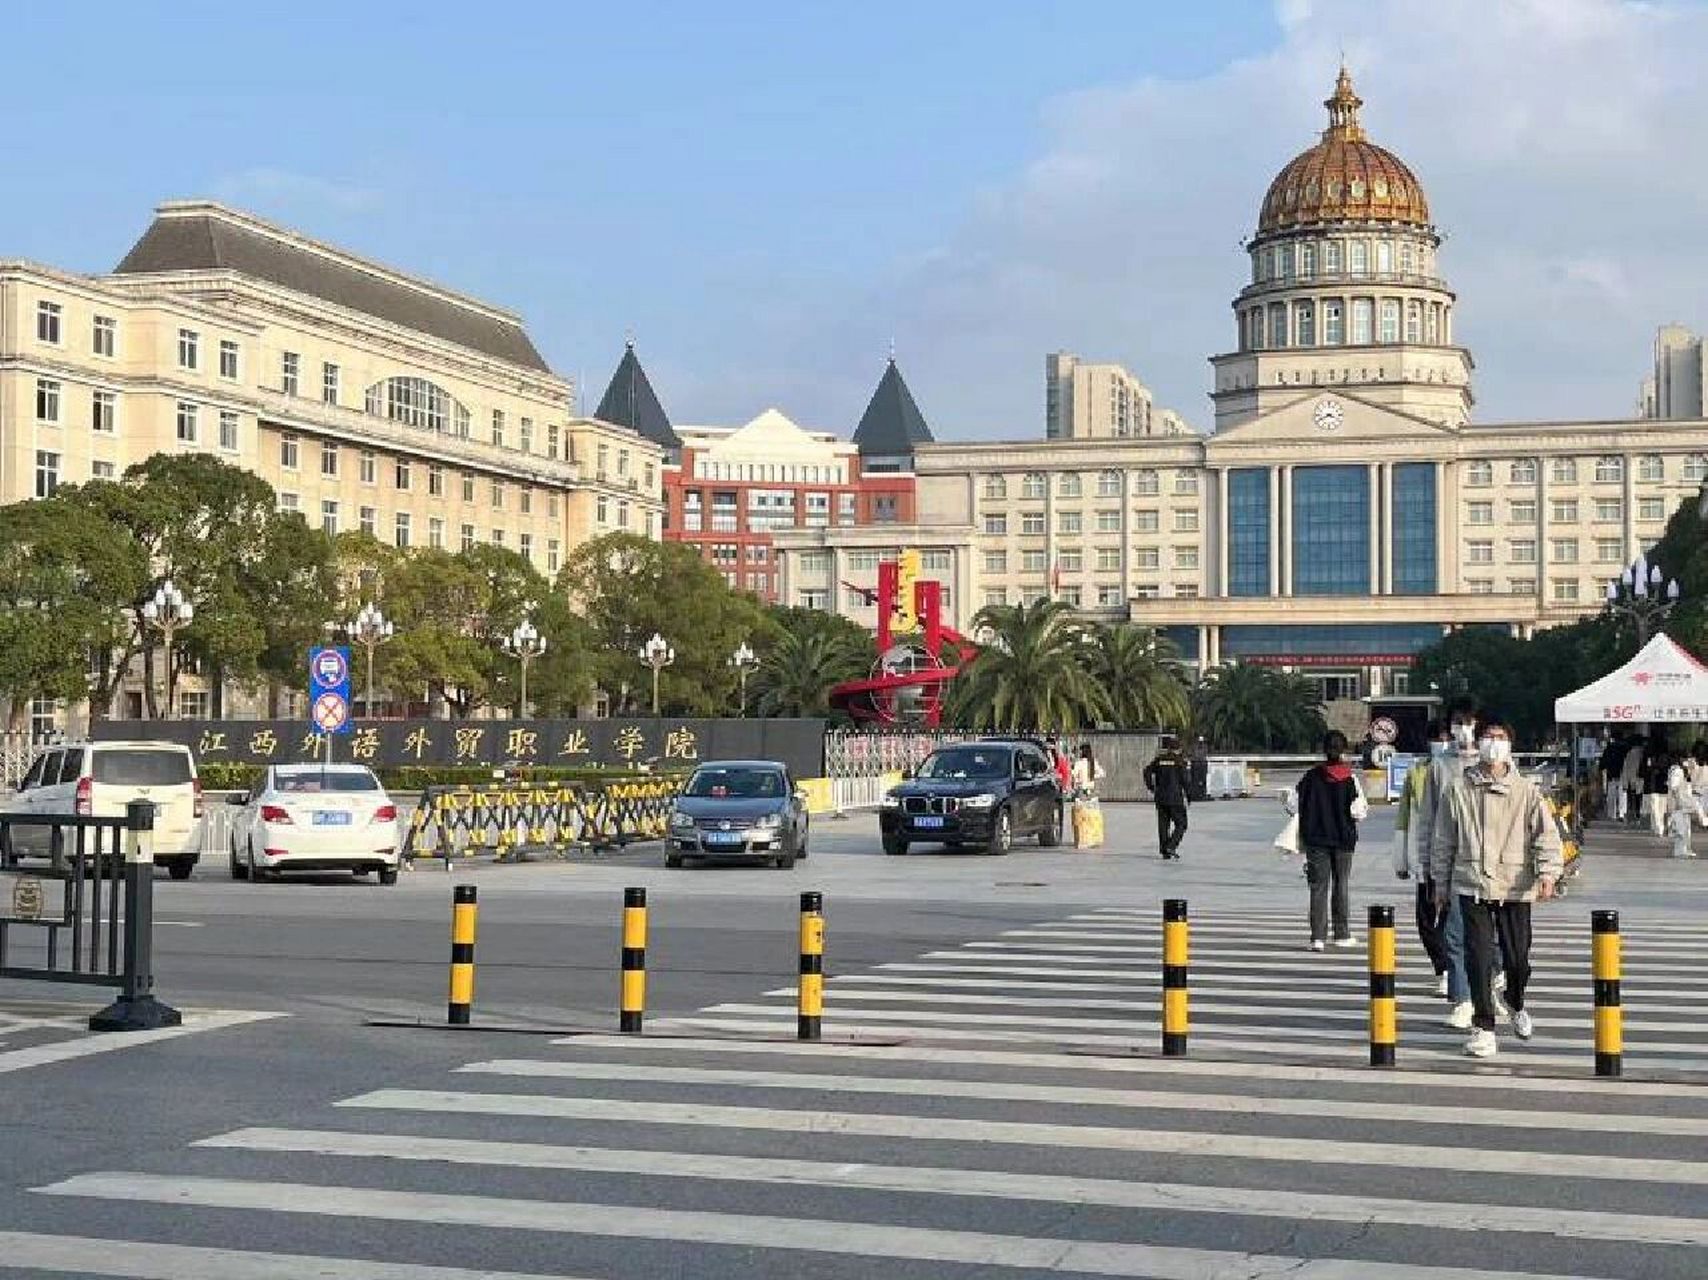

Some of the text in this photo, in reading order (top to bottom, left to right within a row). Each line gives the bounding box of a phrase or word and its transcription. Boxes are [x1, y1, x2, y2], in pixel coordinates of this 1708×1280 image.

[199, 726, 698, 759] 江西外语外贸职业学院
